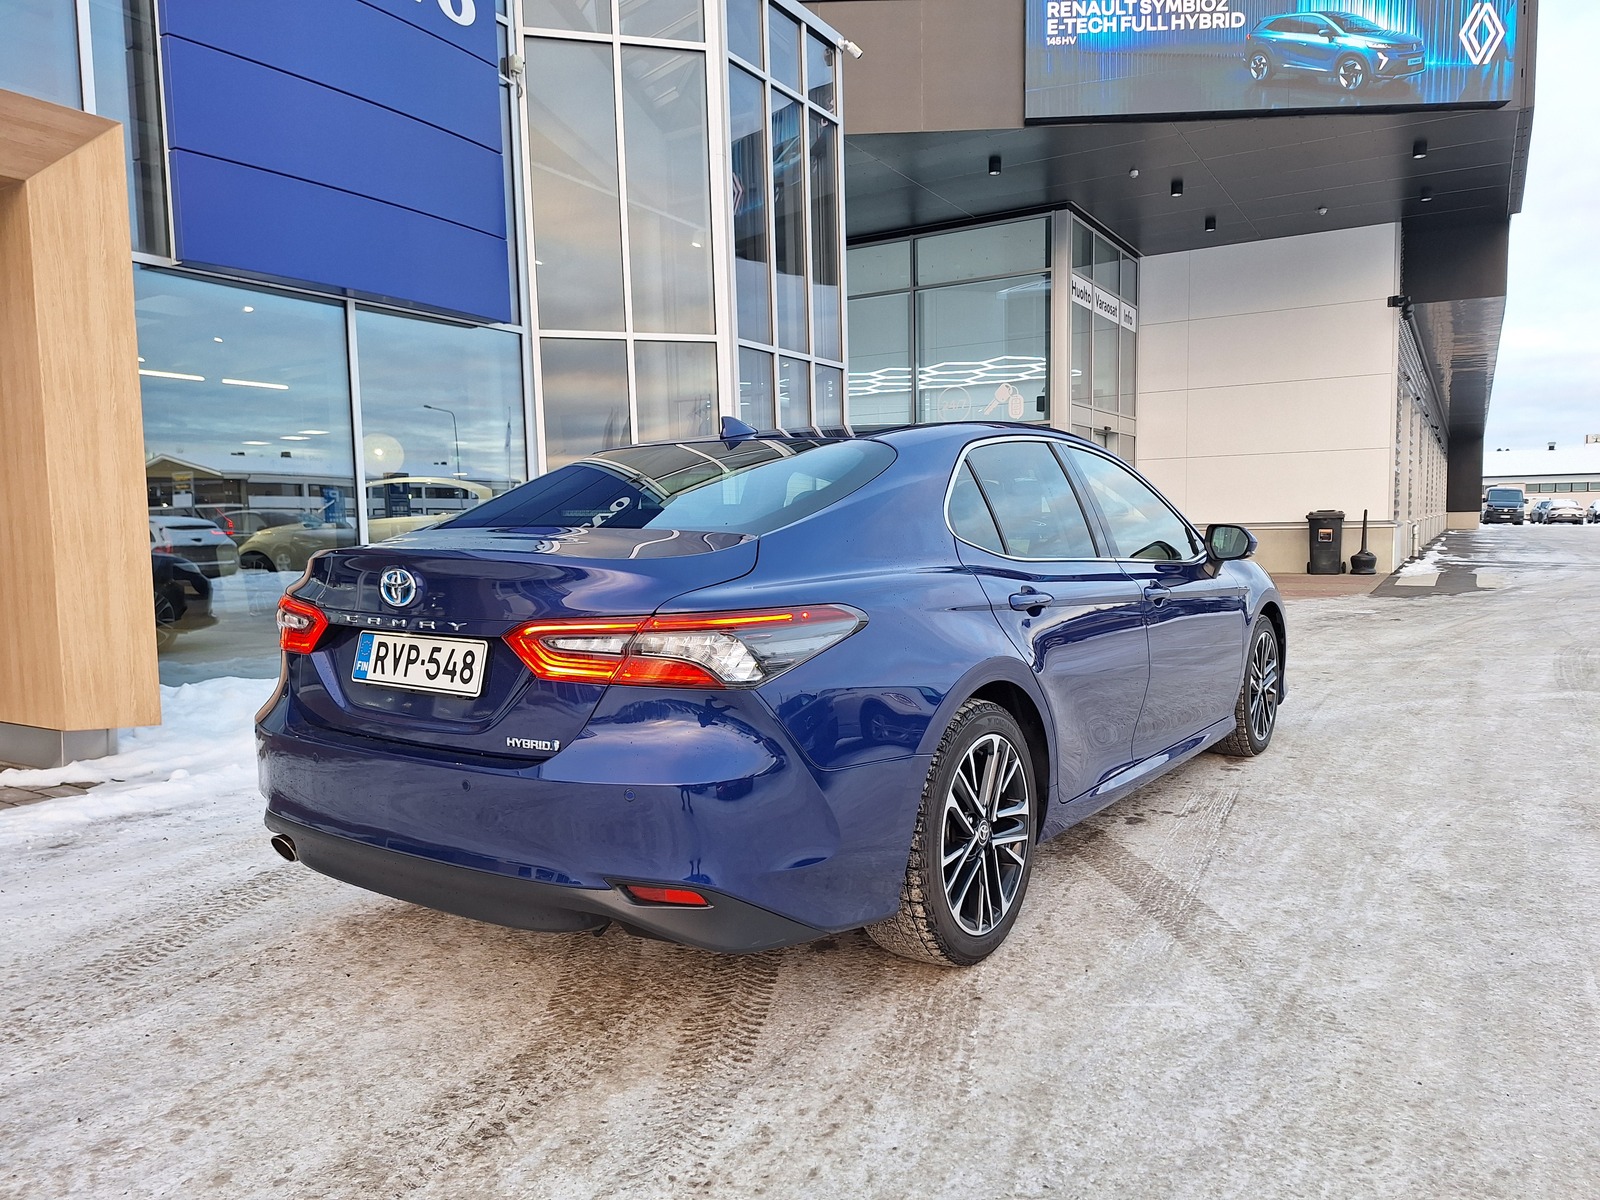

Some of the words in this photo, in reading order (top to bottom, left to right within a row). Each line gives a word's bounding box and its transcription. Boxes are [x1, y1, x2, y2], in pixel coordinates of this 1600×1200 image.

[1047, 0, 1139, 17] RENAULT
[1140, 0, 1229, 14] SYMBIOZ
[1047, 16, 1118, 35] E-TECH
[1120, 14, 1168, 32] FULL
[1171, 12, 1246, 30] HYBRID
[1072, 280, 1092, 304] Huolto
[1095, 293, 1118, 318] Varaosat
[1123, 309, 1133, 326] Info
[344, 614, 468, 631] CAMRY
[356, 661, 369, 672] FIN
[372, 641, 476, 685] RVP-548
[506, 737, 551, 751] HYBRID
